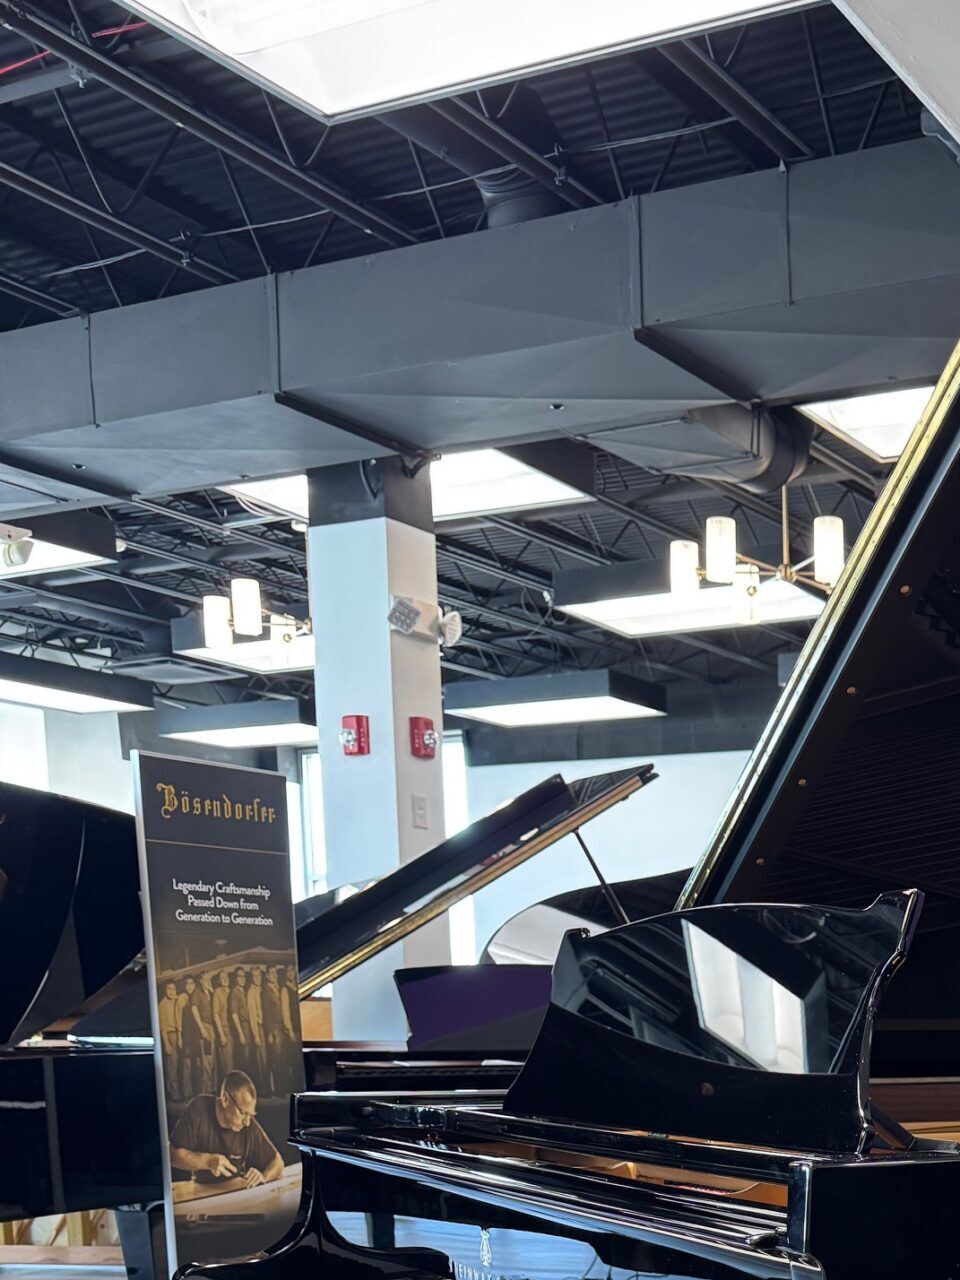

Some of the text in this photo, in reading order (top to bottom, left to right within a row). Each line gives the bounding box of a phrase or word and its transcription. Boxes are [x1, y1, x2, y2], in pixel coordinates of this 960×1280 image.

[156, 782, 276, 824] Bösendorfer
[172, 878, 271, 900] Legendary Craftsmanship
[187, 894, 259, 910] Passed Down from
[175, 909, 273, 926] Generation to Generation
